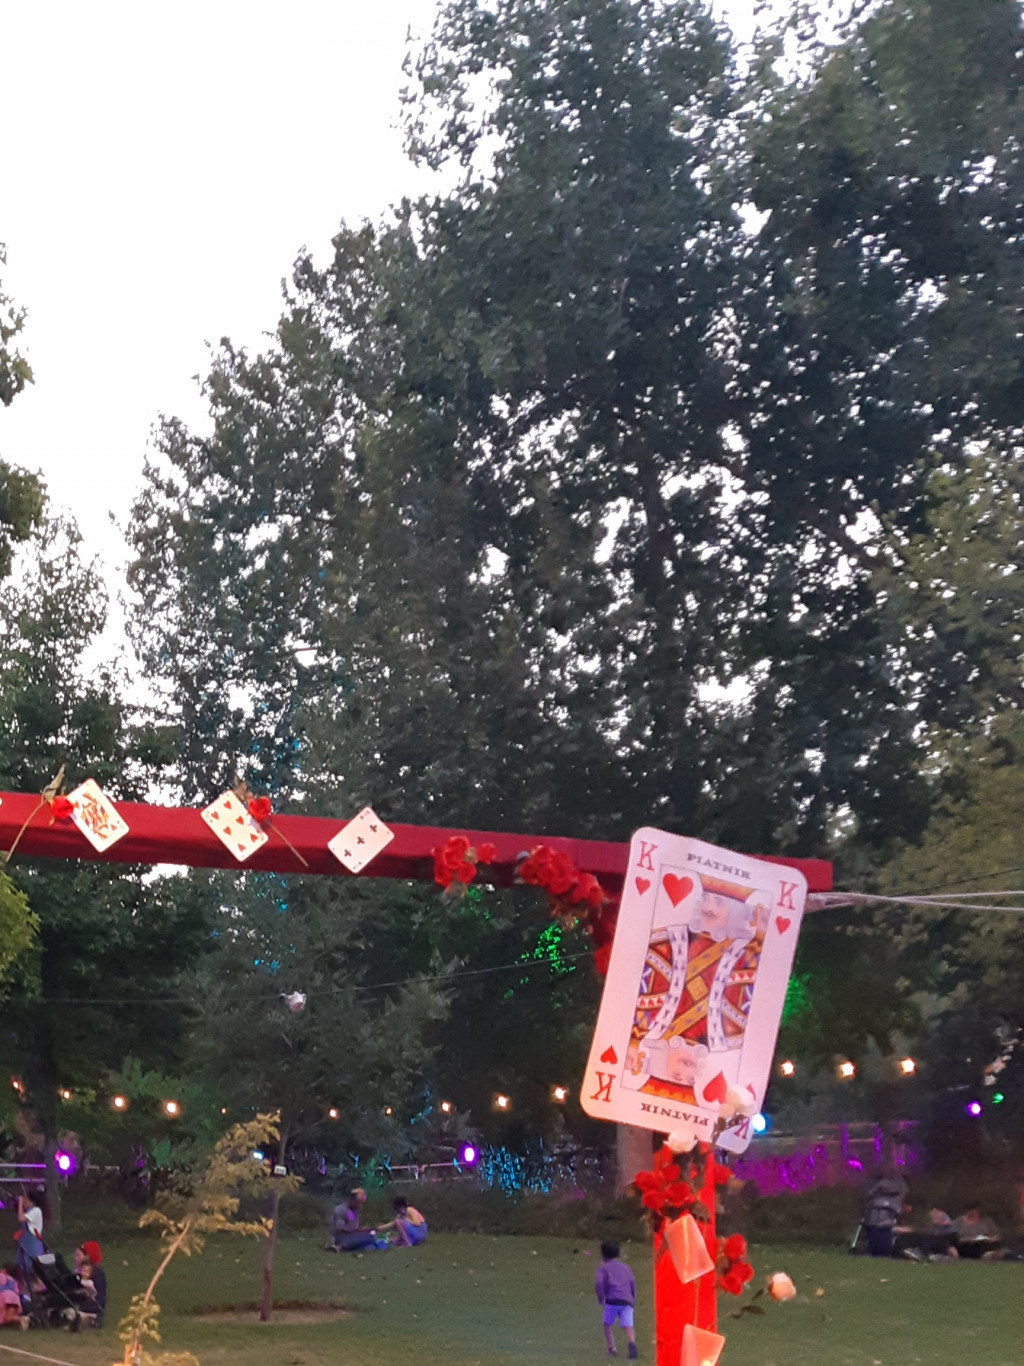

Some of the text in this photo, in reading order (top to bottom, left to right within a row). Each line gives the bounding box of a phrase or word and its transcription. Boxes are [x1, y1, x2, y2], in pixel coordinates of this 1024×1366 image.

[636, 840, 659, 871] K
[686, 852, 753, 880] PIATNIK
[777, 880, 799, 911] K
[590, 1071, 616, 1103] K
[640, 1102, 710, 1127] PIATNIK
